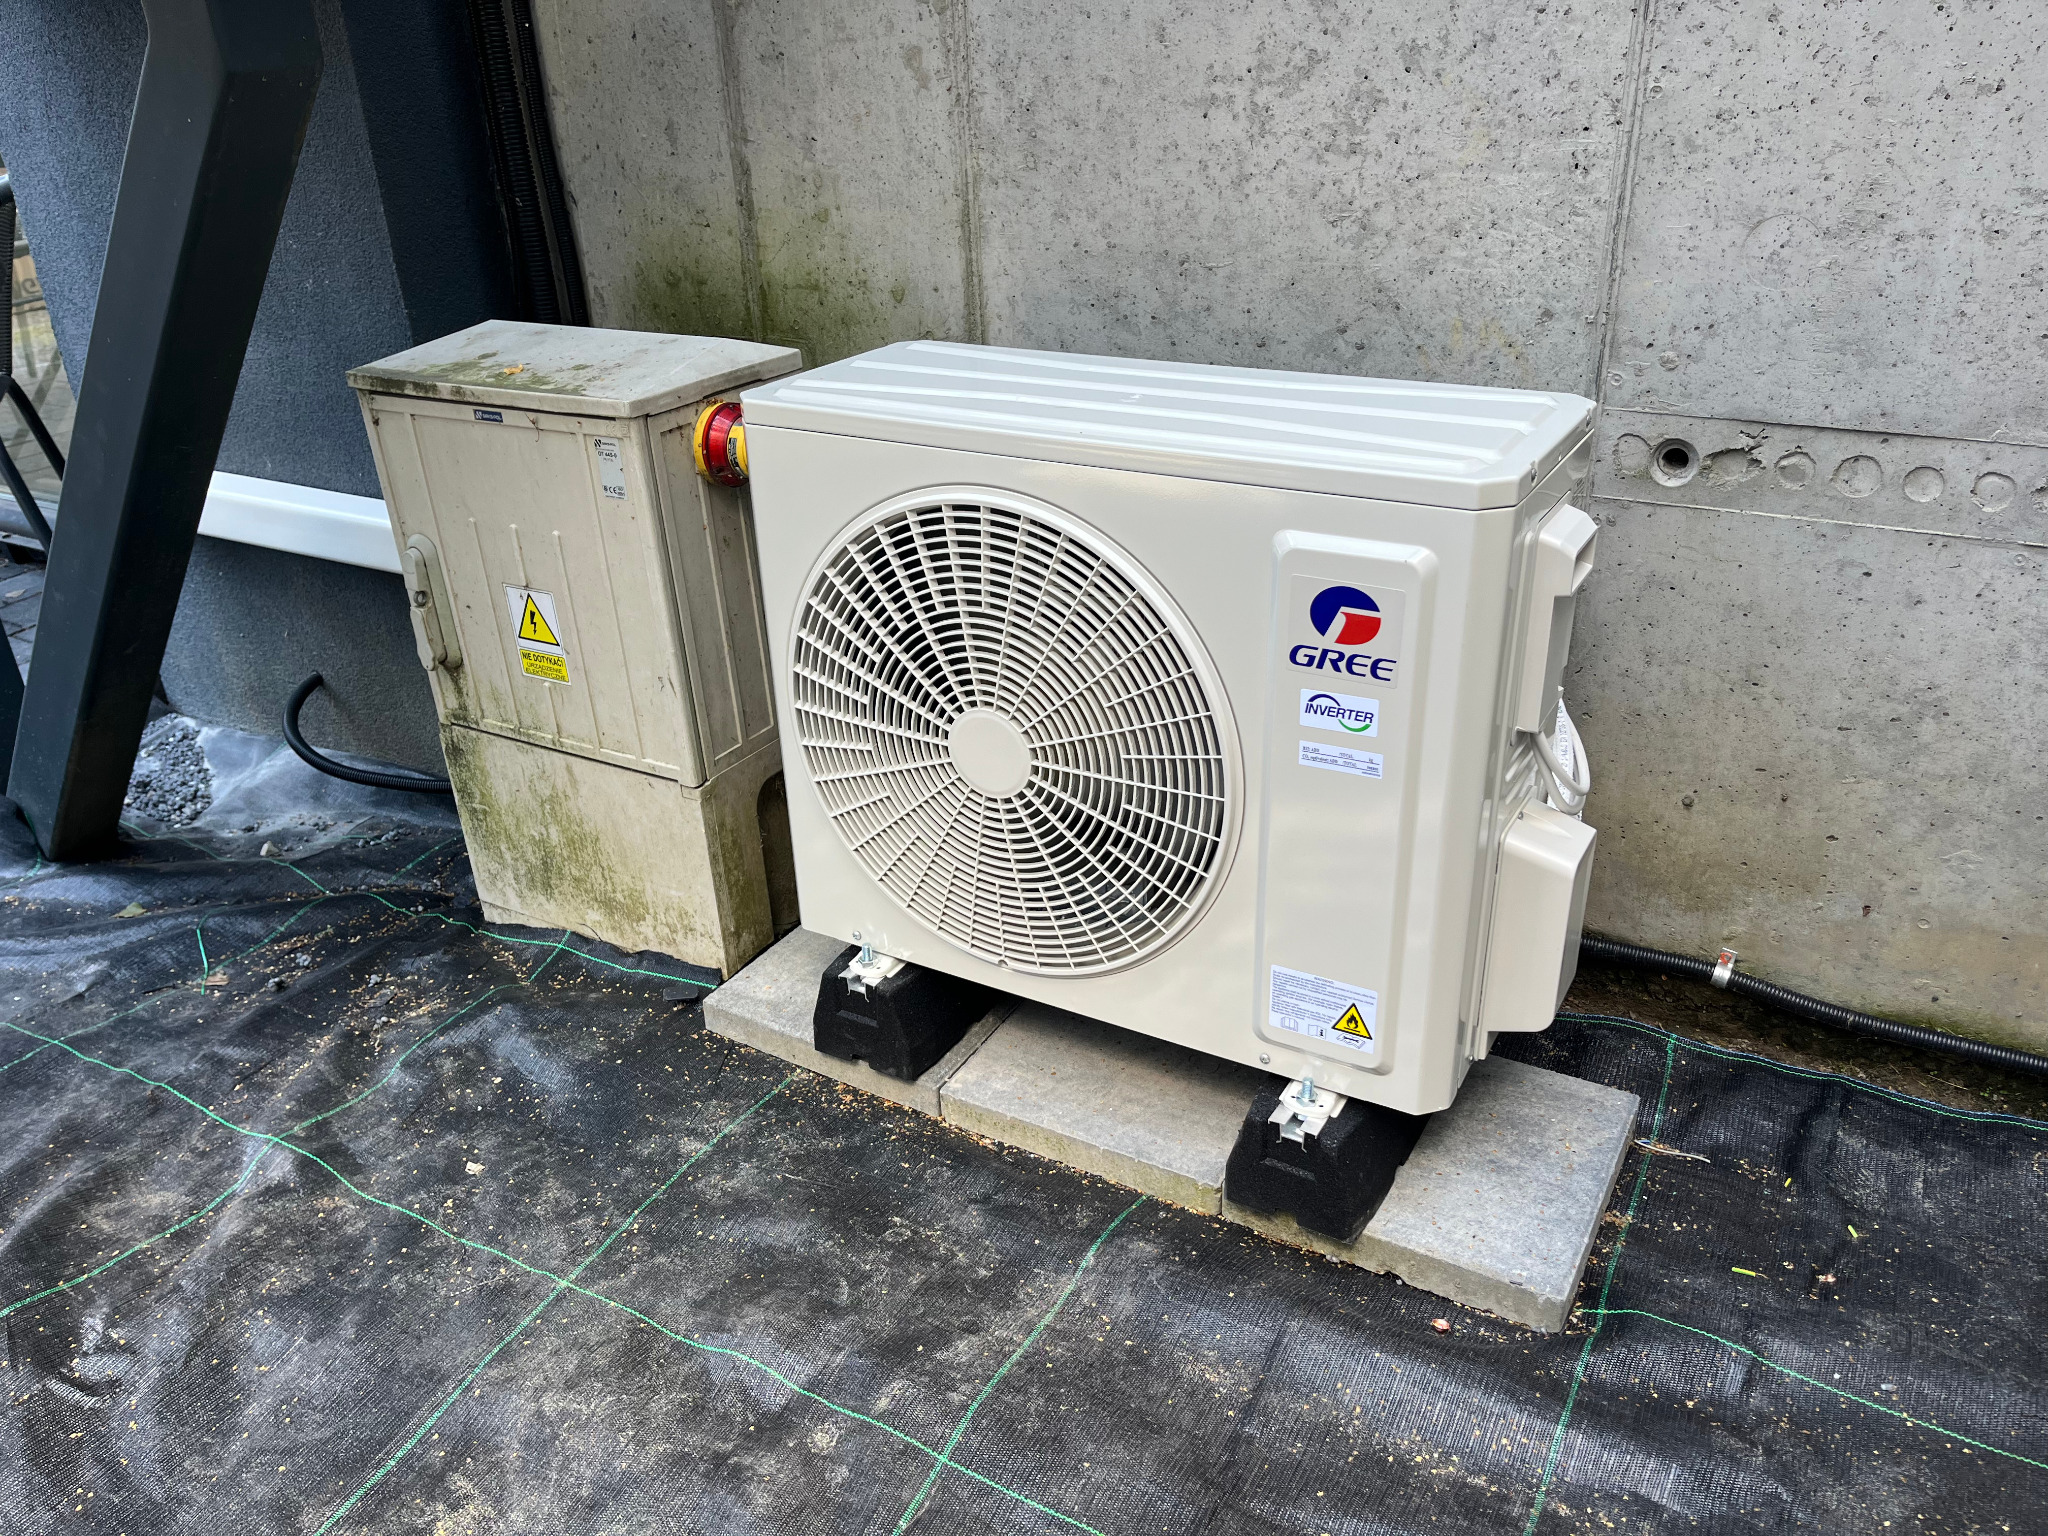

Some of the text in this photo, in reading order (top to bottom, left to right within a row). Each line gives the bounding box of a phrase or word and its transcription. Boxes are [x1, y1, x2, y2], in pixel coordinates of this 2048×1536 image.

[522, 651, 532, 660] NIE
[1289, 644, 1397, 682] GREE
[1304, 702, 1374, 724] INVERTER
